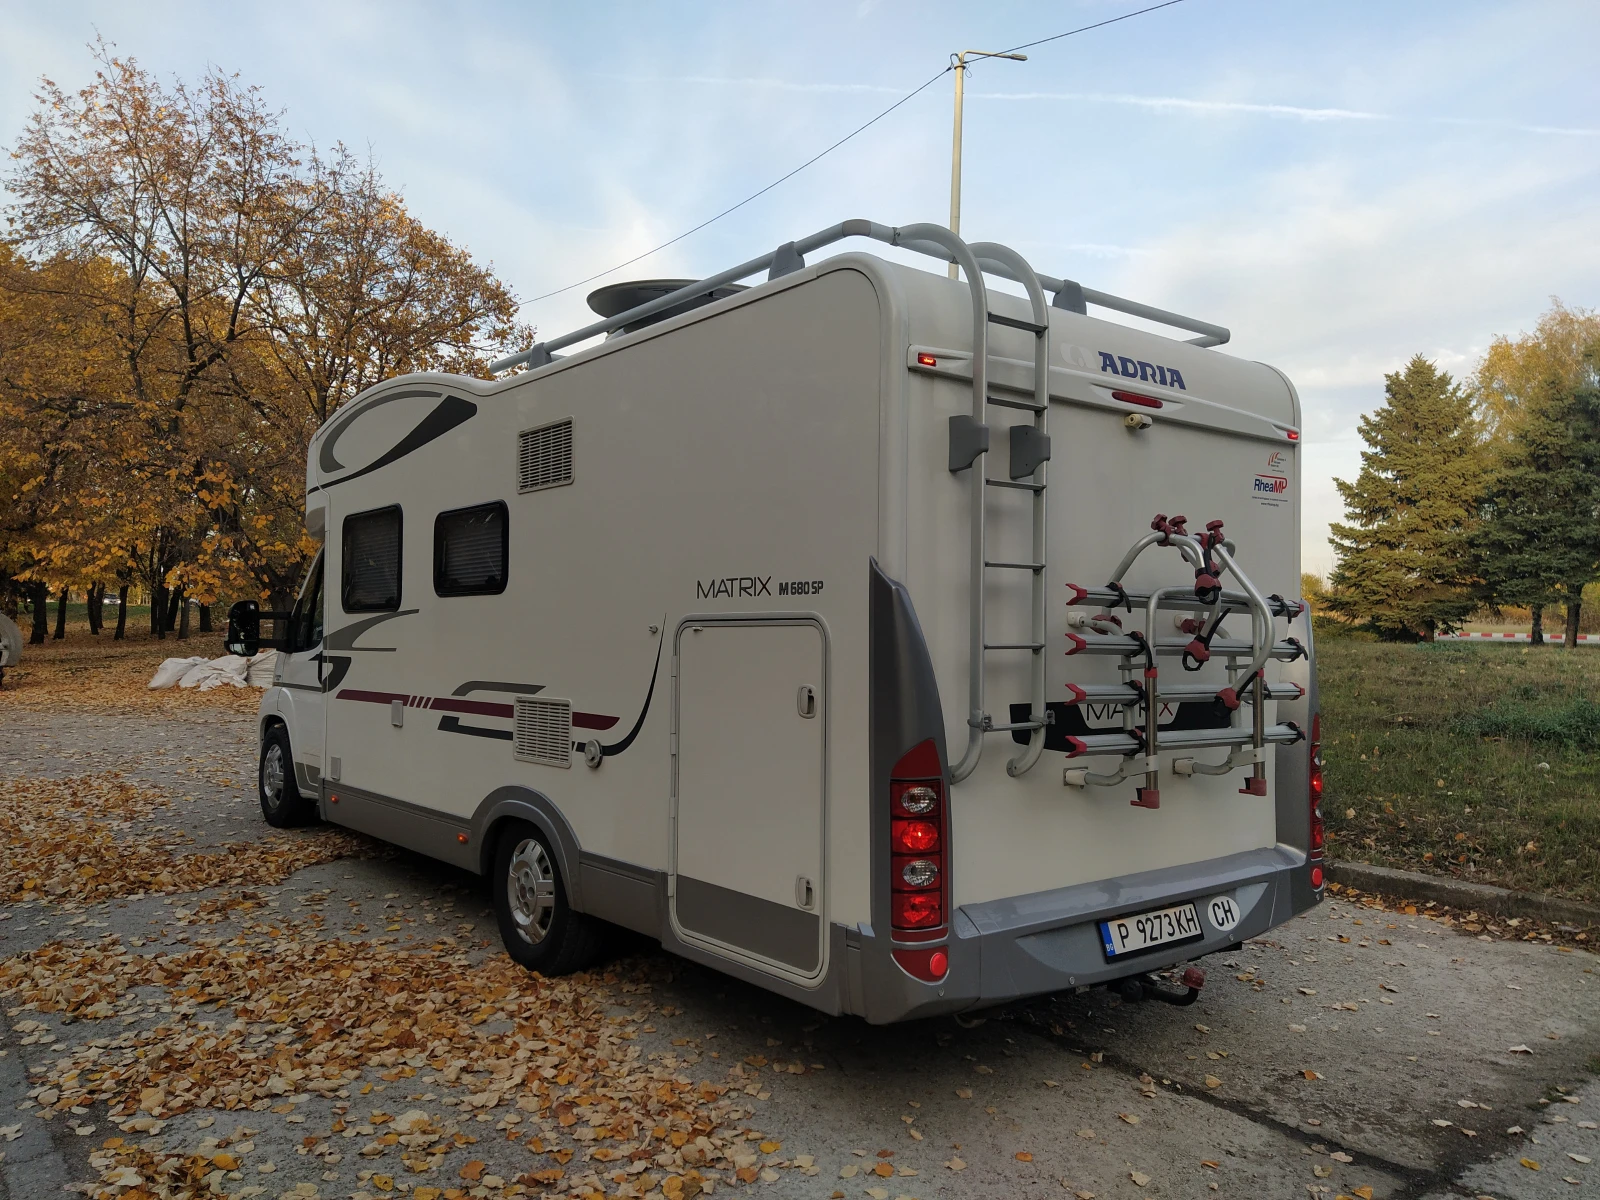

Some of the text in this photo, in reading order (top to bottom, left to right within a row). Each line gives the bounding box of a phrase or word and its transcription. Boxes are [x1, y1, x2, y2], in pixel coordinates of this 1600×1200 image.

[1098, 351, 1187, 390] ADRIA
[696, 576, 771, 600] MATRIX
[1212, 900, 1236, 927] CH
[1105, 943, 1115, 951] BG
[1117, 922, 1129, 949] P
